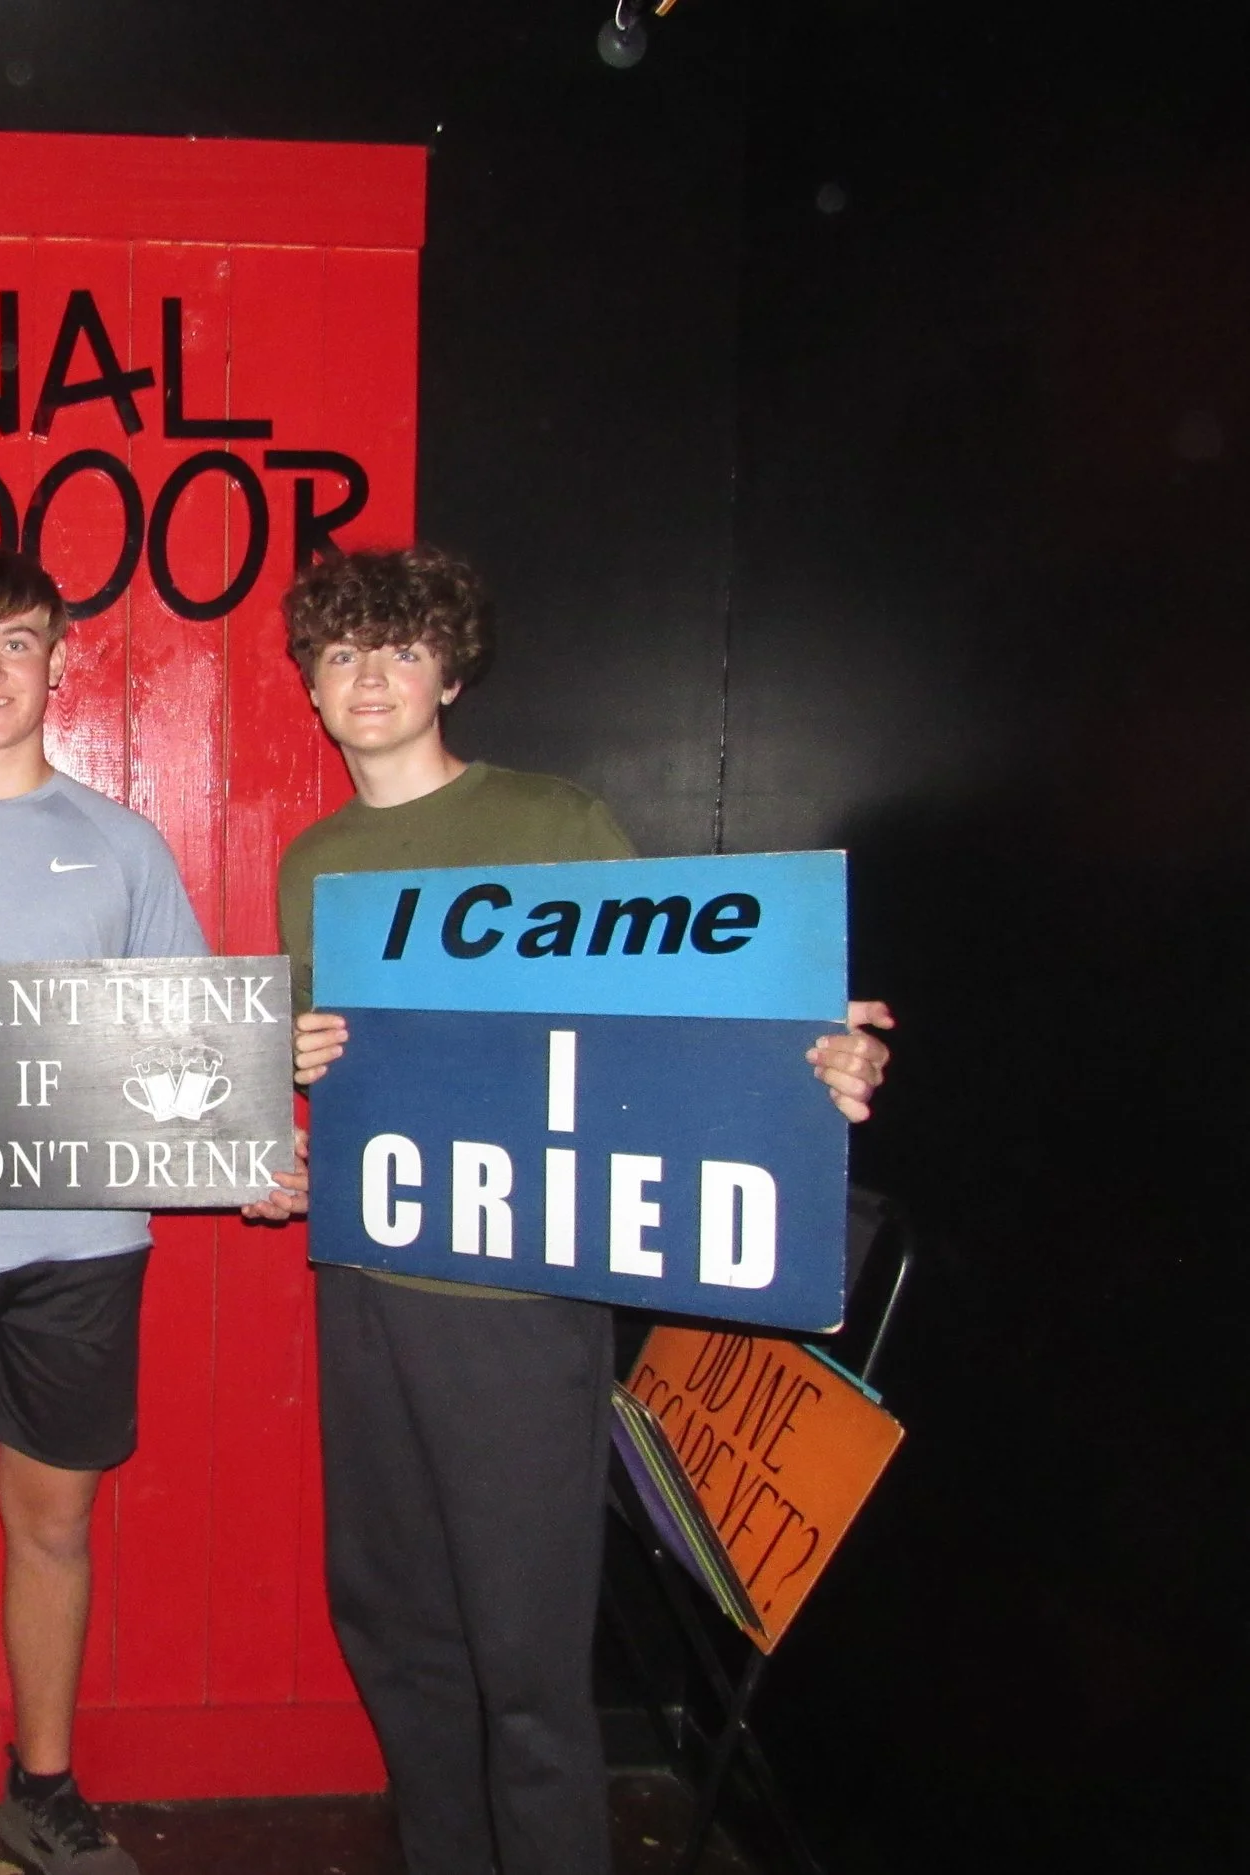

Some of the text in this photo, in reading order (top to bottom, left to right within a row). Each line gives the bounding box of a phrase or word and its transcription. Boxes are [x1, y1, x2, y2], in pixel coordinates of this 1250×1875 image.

[382, 882, 762, 961] I Came
[104, 975, 278, 1025] THINK
[15, 1060, 63, 1108] IF
[547, 1030, 577, 1133] I
[105, 1139, 280, 1189] DRINK
[361, 1132, 778, 1290] CRIED
[685, 1332, 823, 1474] DID WE
[717, 1460, 821, 1614] YET?
